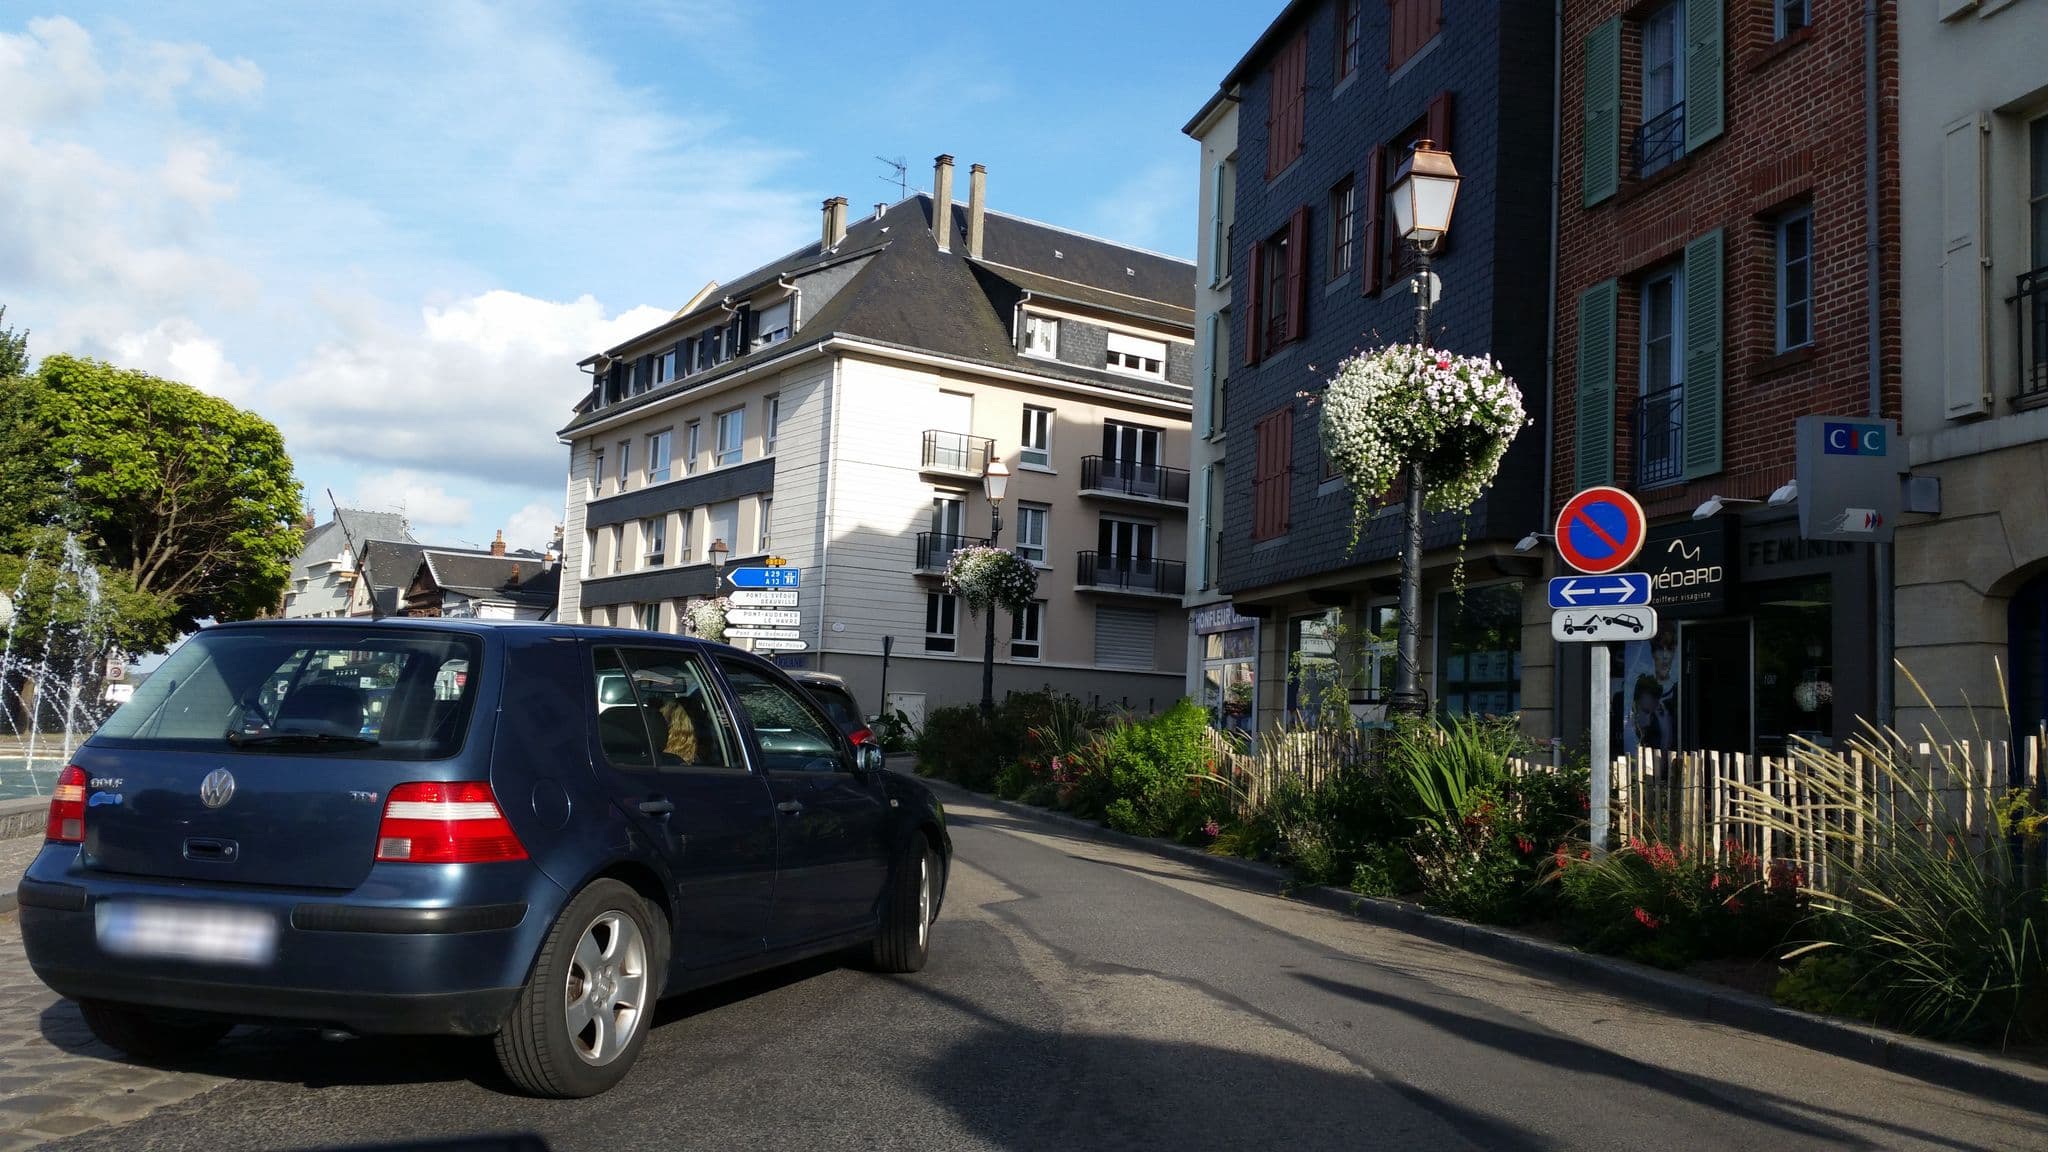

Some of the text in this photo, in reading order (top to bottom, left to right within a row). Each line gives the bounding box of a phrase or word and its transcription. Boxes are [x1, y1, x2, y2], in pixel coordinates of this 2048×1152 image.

[1829, 428, 1880, 451] CIC
[771, 570, 780, 578] 29
[1195, 608, 1231, 629] HONFLEUR
[89, 777, 124, 788] GOLF
[348, 790, 378, 802] TDI
